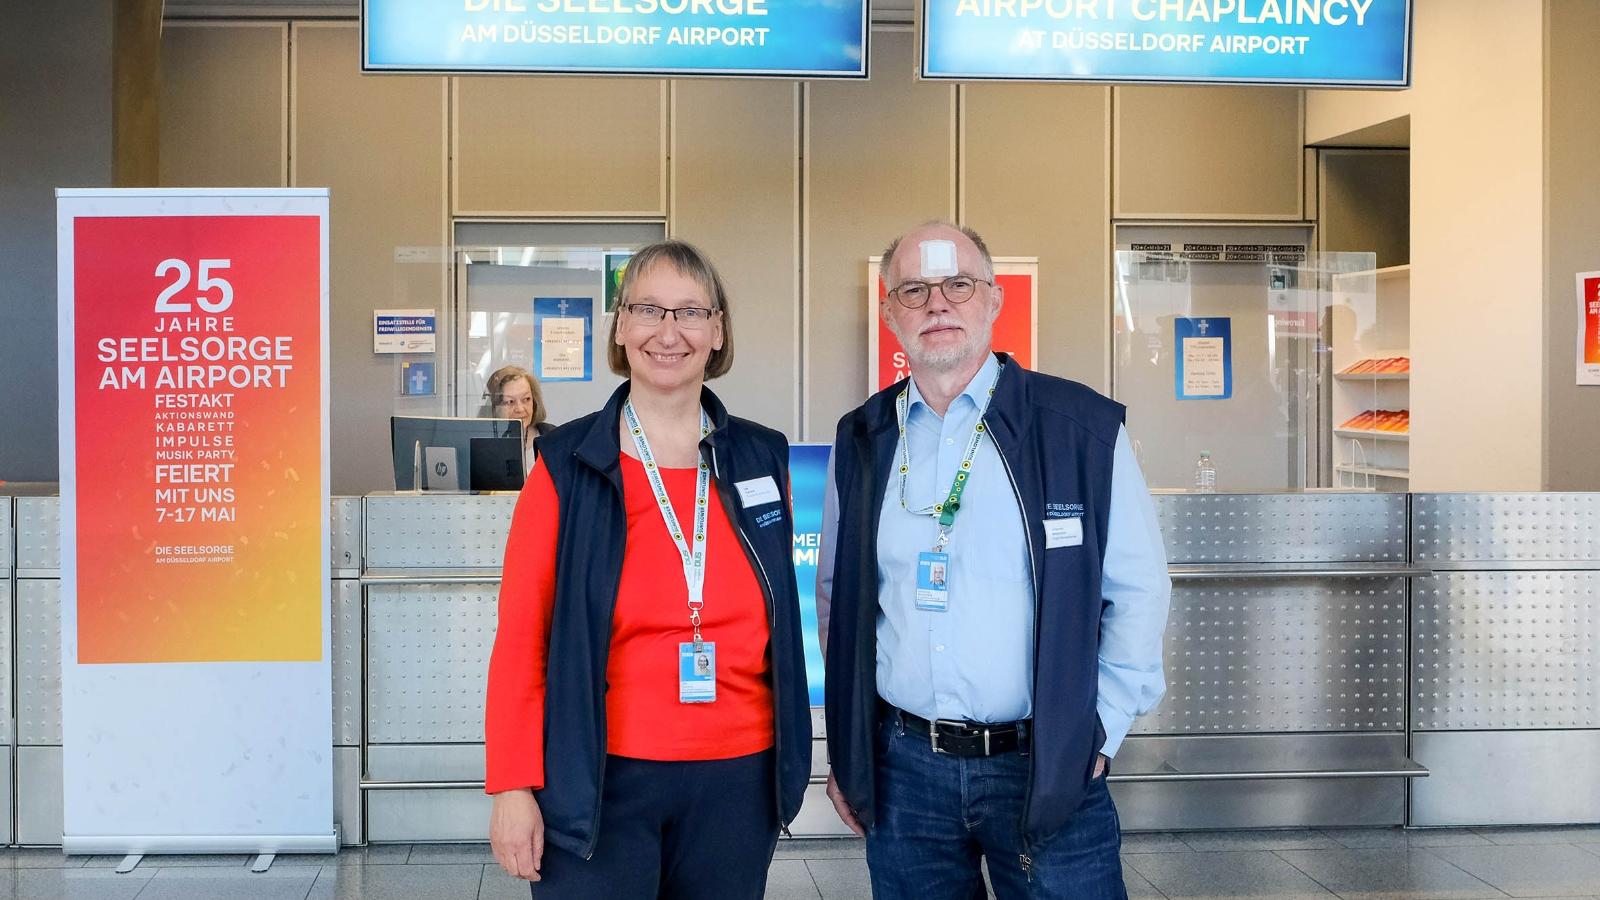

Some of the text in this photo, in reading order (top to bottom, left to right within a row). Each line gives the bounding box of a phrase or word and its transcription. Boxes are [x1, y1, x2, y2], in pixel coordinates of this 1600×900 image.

[1131, 0, 1375, 26] CHAPLAINCY
[461, 20, 770, 46] AM DÜSSELDORF AIRPORT
[1018, 27, 1309, 54] AT DÜSSELDORF AIRPORT
[154, 258, 234, 313] 25
[155, 317, 234, 332] JAHRE
[97, 336, 293, 362] SEELSORGE
[99, 365, 293, 390] AM AIRPORT
[155, 394, 234, 408] FESTAKT
[155, 411, 234, 420] AKTIONSWAND
[156, 422, 234, 432] KABARETT
[156, 436, 234, 447] IMPULSE
[156, 450, 235, 460] MUSIK PARTY
[155, 464, 234, 484] FEIERT
[156, 487, 235, 504] MIT UNS
[156, 507, 236, 523] 7-17 MAI
[155, 545, 234, 555] DIE SEELSORGE
